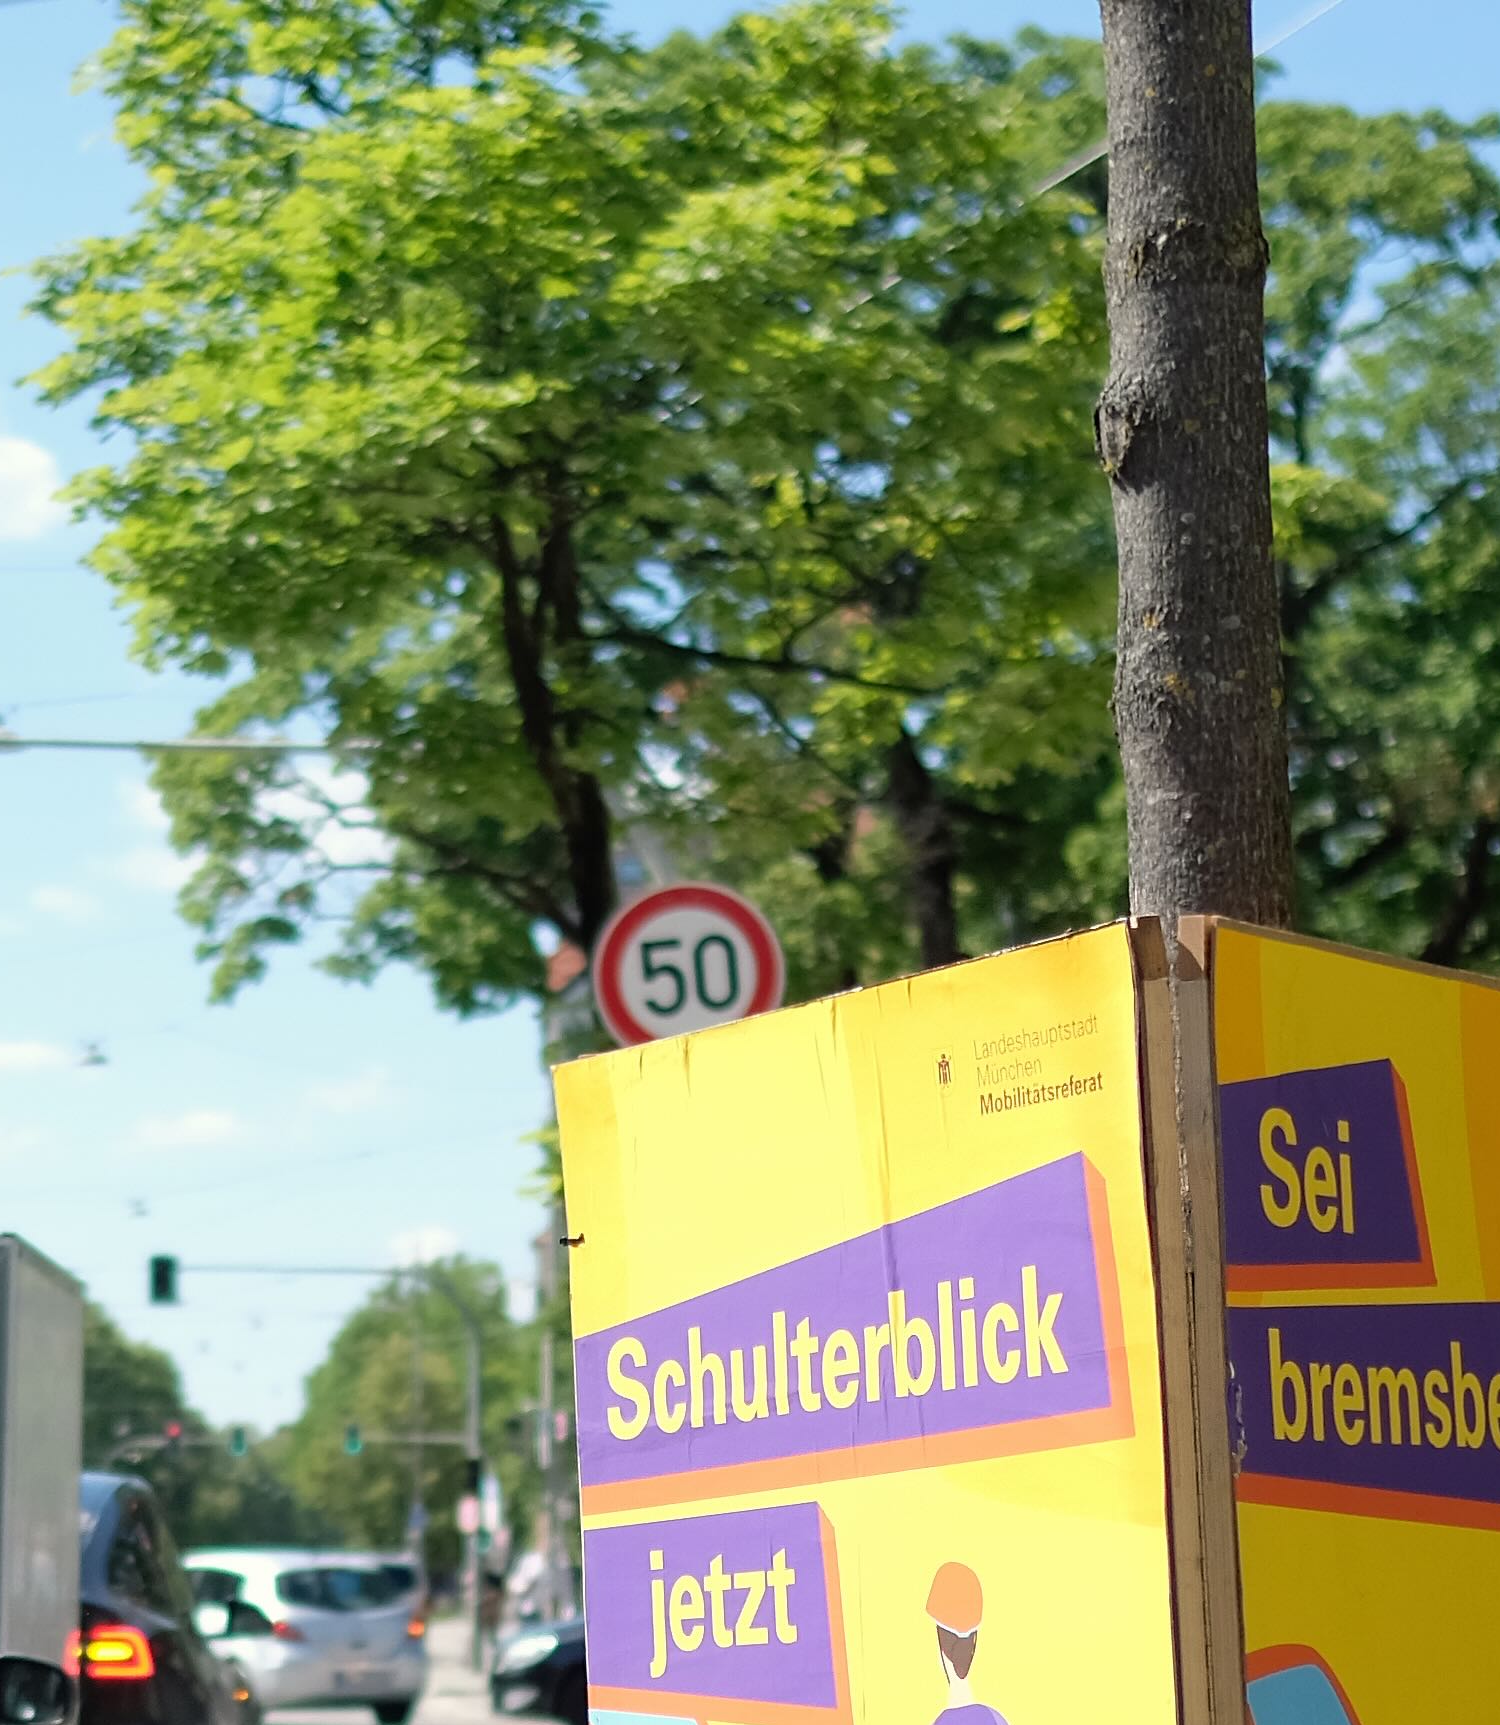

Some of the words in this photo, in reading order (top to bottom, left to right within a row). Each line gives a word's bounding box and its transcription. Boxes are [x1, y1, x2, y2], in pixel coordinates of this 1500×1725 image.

[641, 935, 740, 1016] 50
[973, 1013, 1099, 1061] Landeshauptstadt
[976, 1058, 1042, 1088] München
[980, 1071, 1104, 1116] Mobilitätsreferat
[1259, 1107, 1355, 1234] Sei
[606, 1265, 1069, 1440] Schulterblick
[649, 1548, 798, 1679] jetzt
